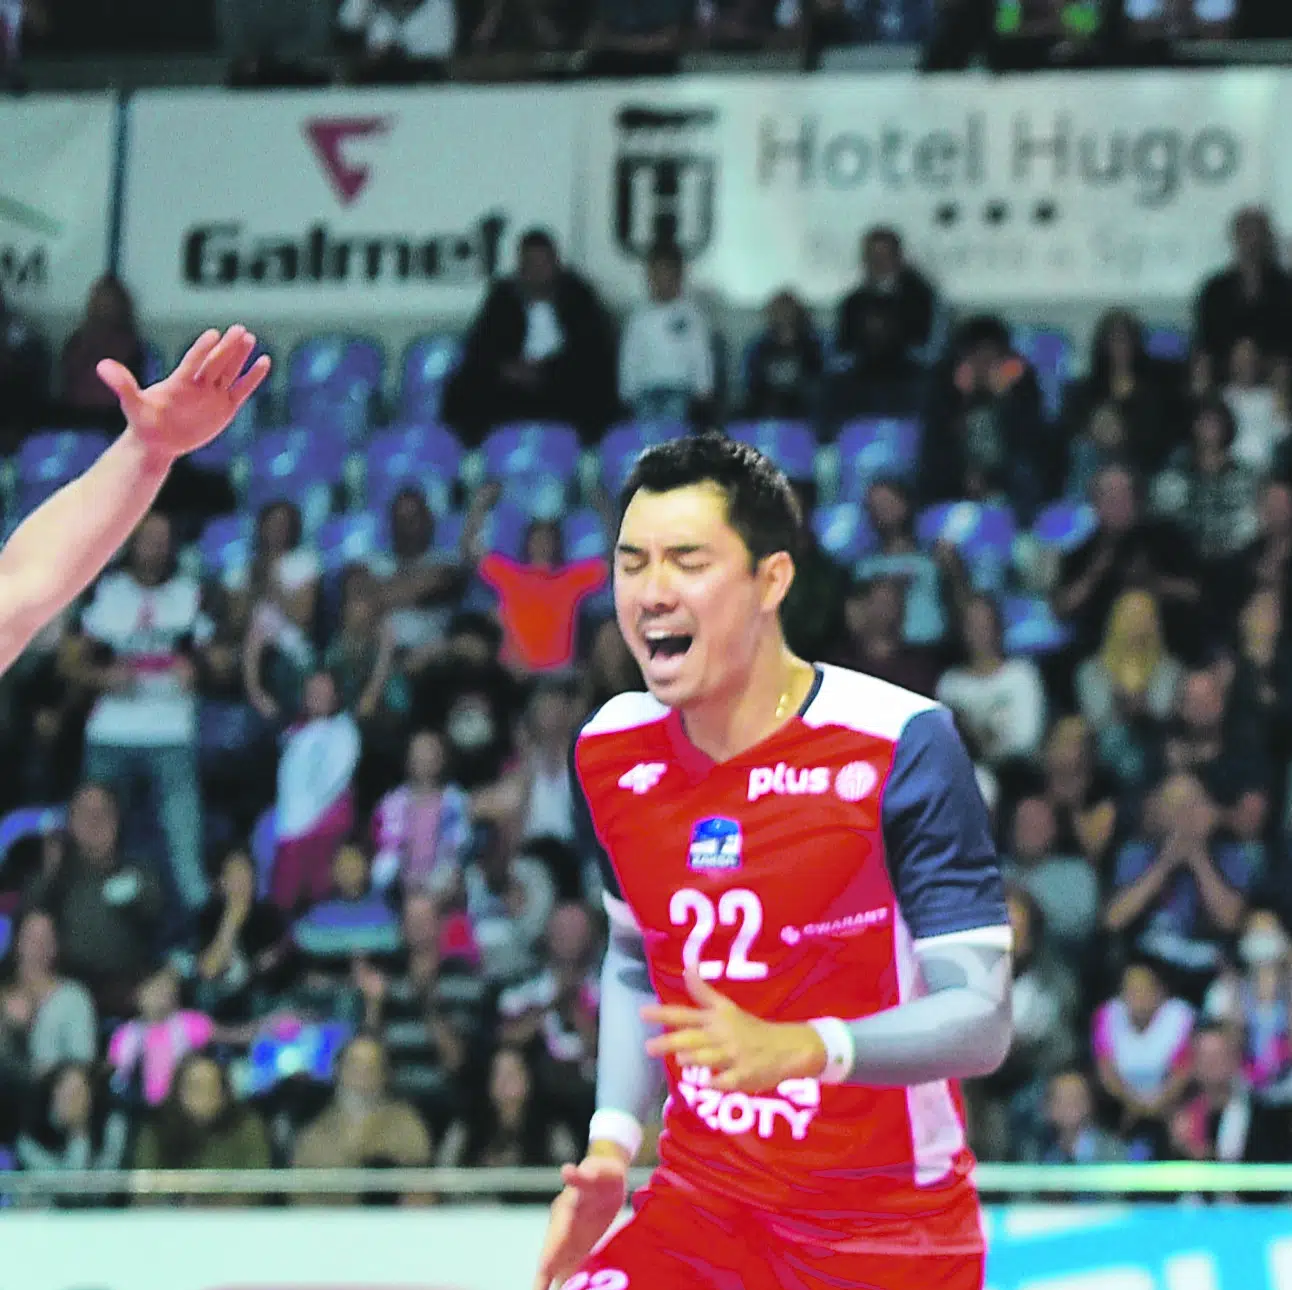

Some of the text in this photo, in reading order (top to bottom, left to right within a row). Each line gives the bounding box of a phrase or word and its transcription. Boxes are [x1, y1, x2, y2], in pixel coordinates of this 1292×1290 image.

[757, 111, 1242, 208] Hotel Hugo
[184, 209, 506, 288] Galmet
[748, 762, 831, 801] plus
[669, 888, 769, 981] 22
